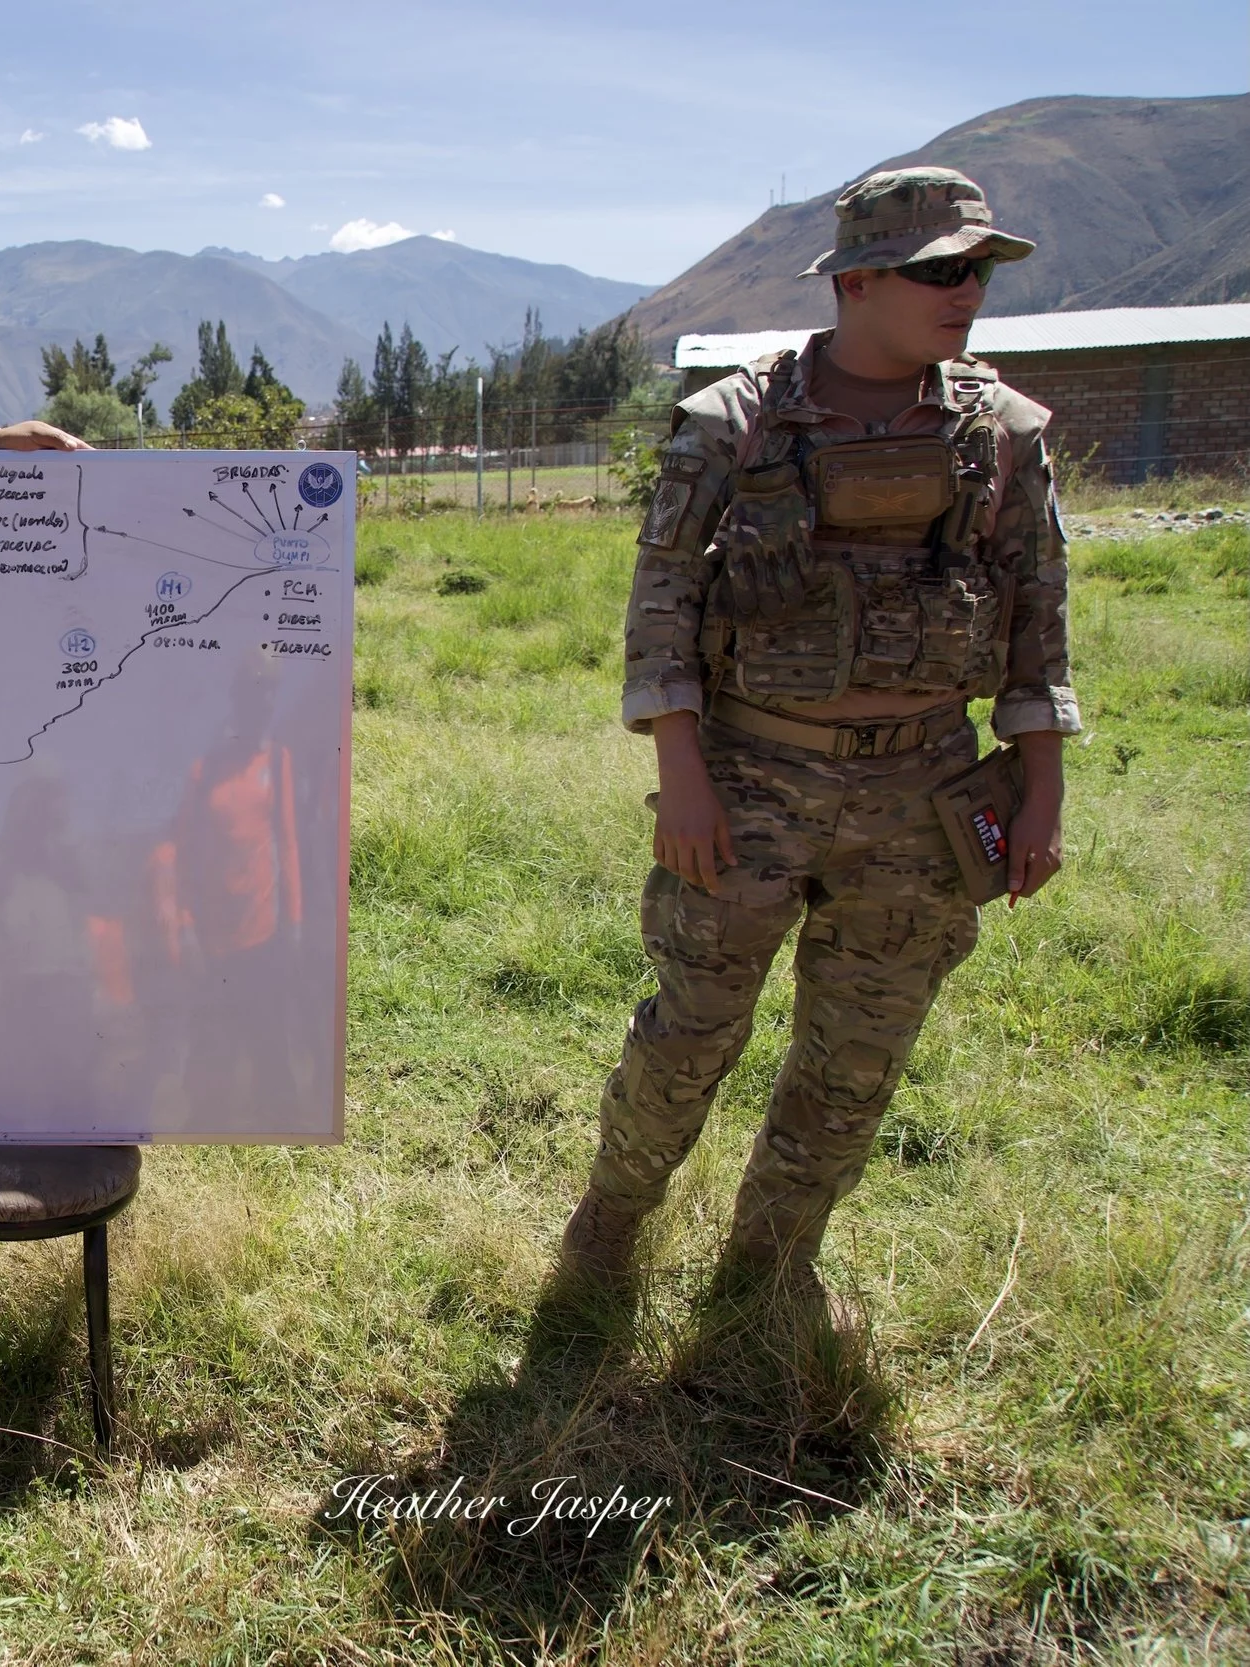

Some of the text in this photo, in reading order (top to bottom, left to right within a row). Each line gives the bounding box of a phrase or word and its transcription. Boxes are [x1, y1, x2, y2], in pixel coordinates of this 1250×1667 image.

[160, 579, 182, 596] H1
[67, 635, 91, 652] H2
[271, 640, 332, 656] TACEVAC
[62, 660, 98, 674] 3800
[973, 814, 1001, 862] PERU
